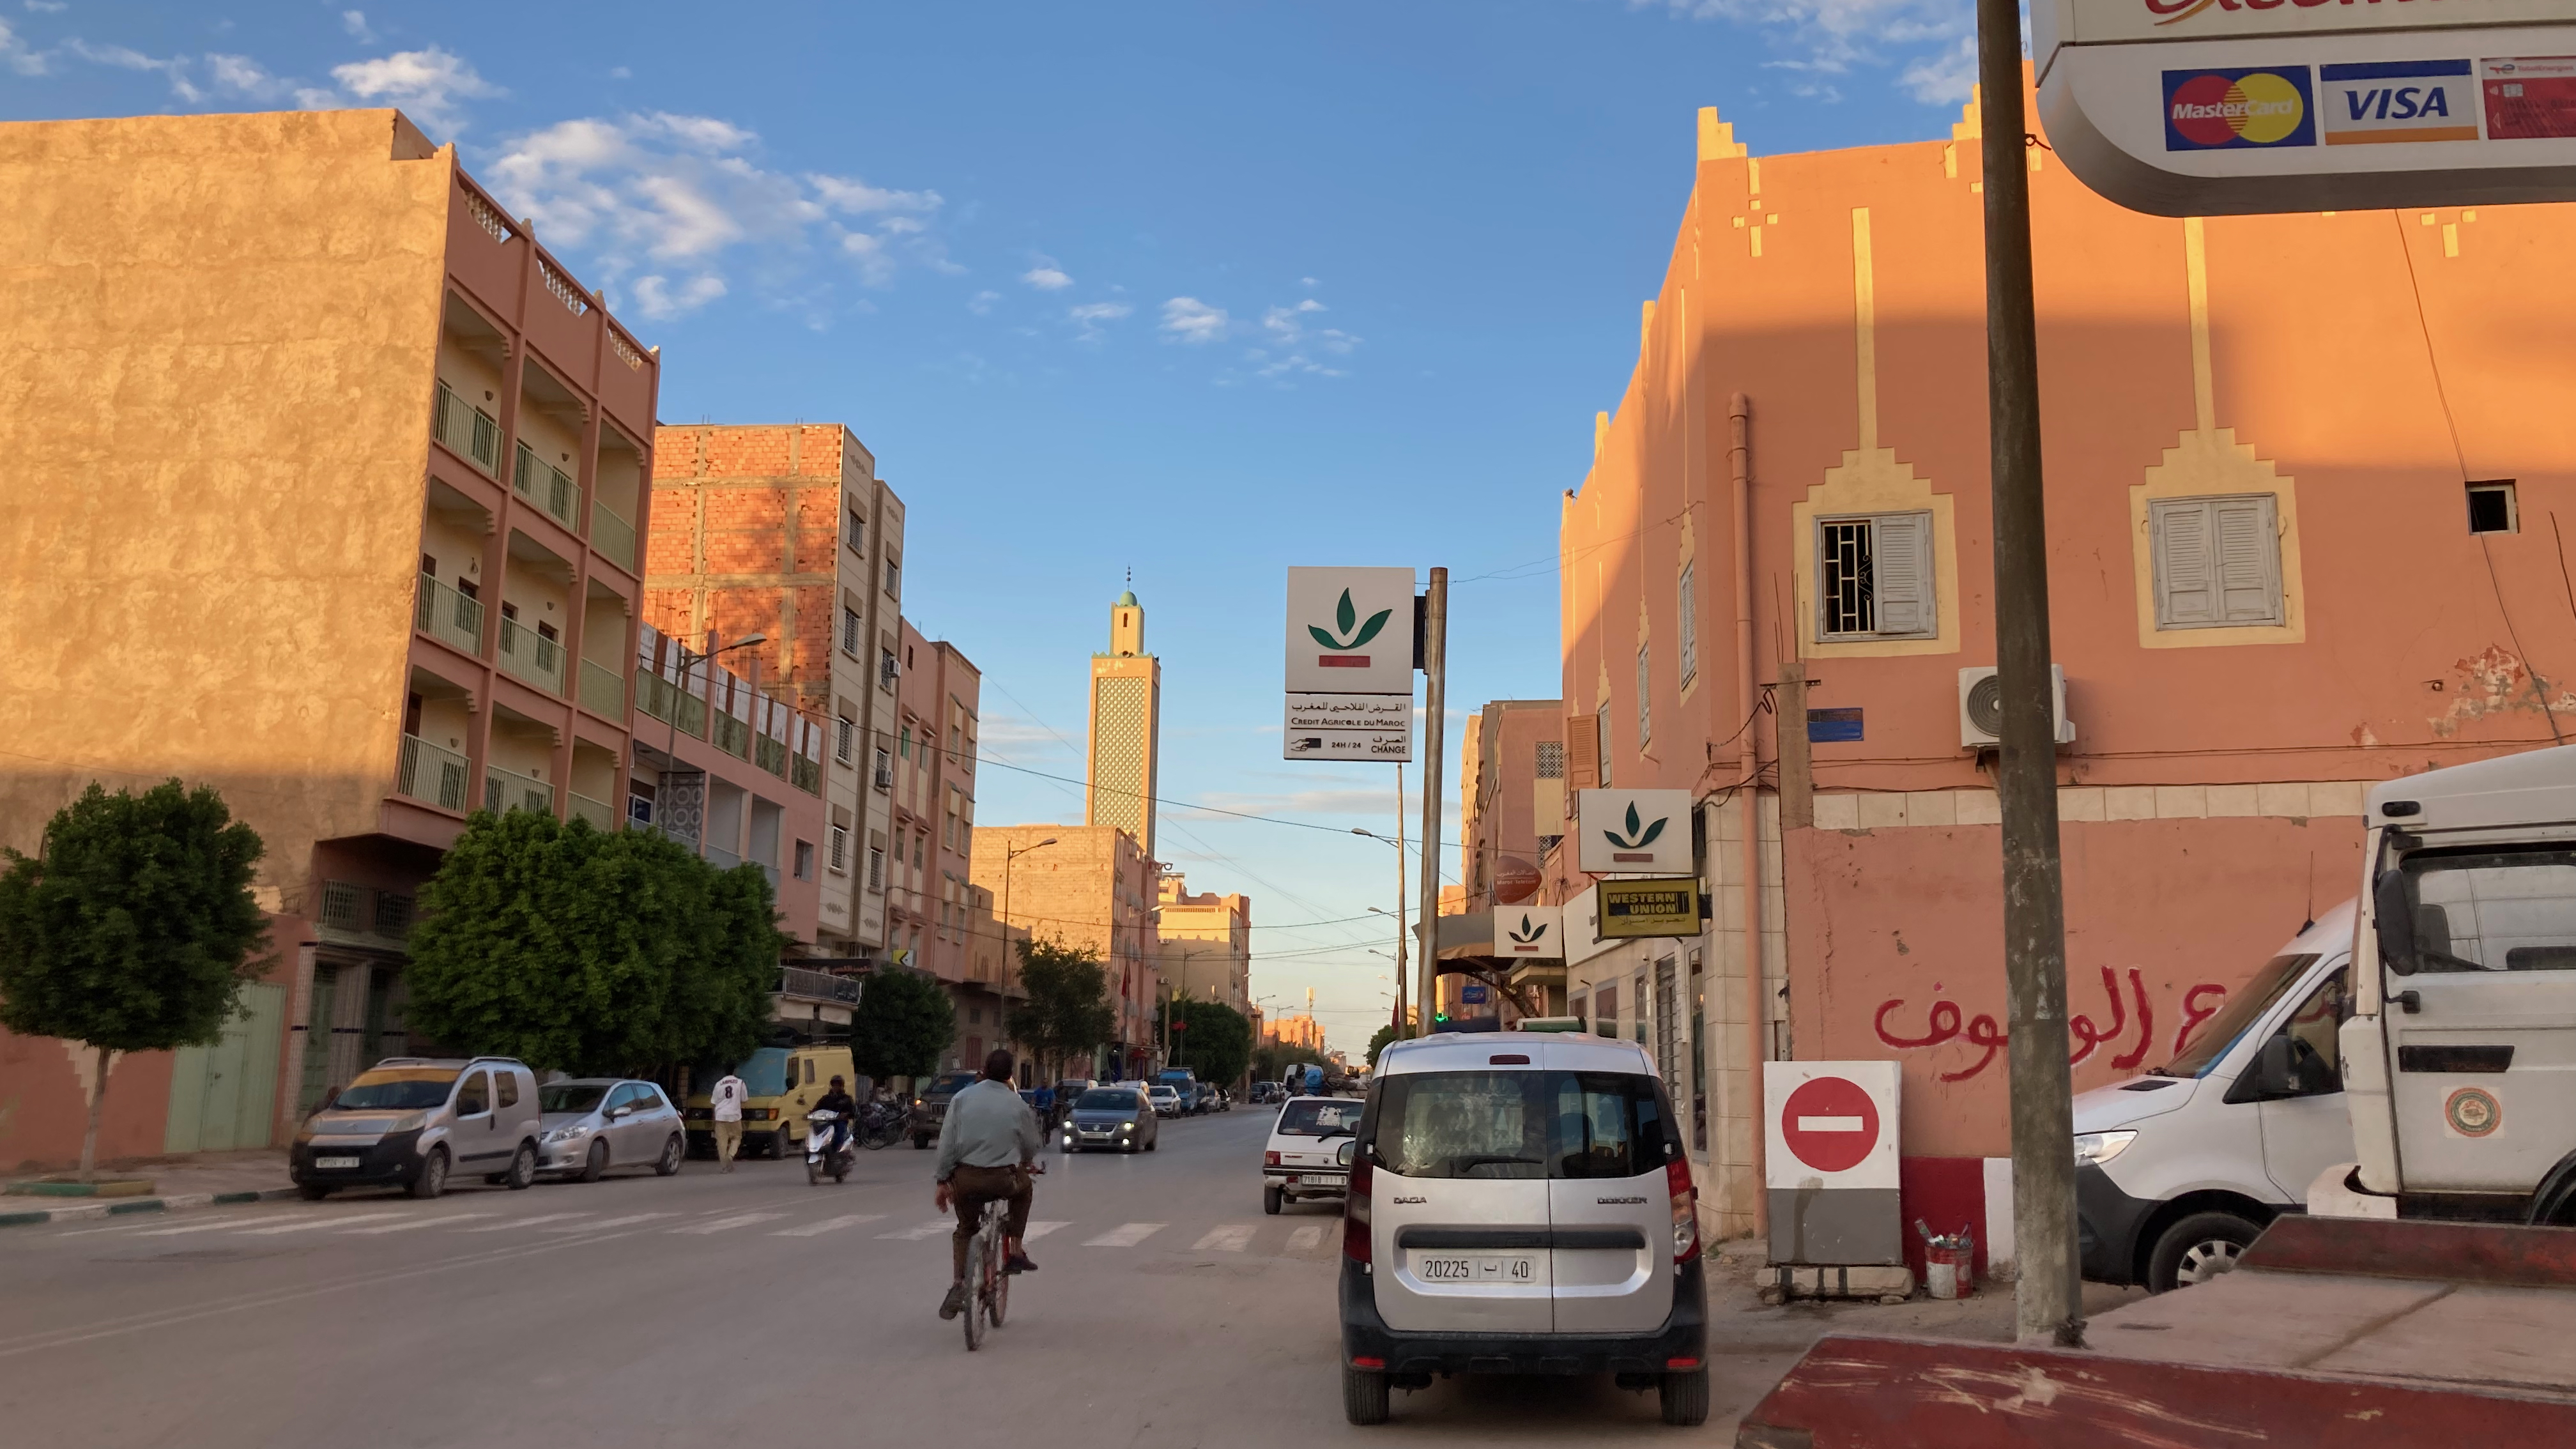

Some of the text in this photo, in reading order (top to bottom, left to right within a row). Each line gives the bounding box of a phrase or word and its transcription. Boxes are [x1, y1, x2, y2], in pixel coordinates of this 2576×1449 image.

[2172, 98, 2294, 119] MasterCard
[2343, 86, 2449, 121] VISA
[1292, 702, 1328, 712] للمغرب
[1368, 703, 1406, 713] القرض
[1291, 717, 1320, 725] CREDIT
[1373, 735, 1406, 745] الصرف
[1371, 745, 1406, 754] CHANGE
[1608, 893, 1676, 904] WESTERN
[1630, 903, 1676, 914] UNION
[725, 1085, 733, 1099] 8
[1425, 1260, 1469, 1278] 20225
[1512, 1261, 1528, 1278] 40
